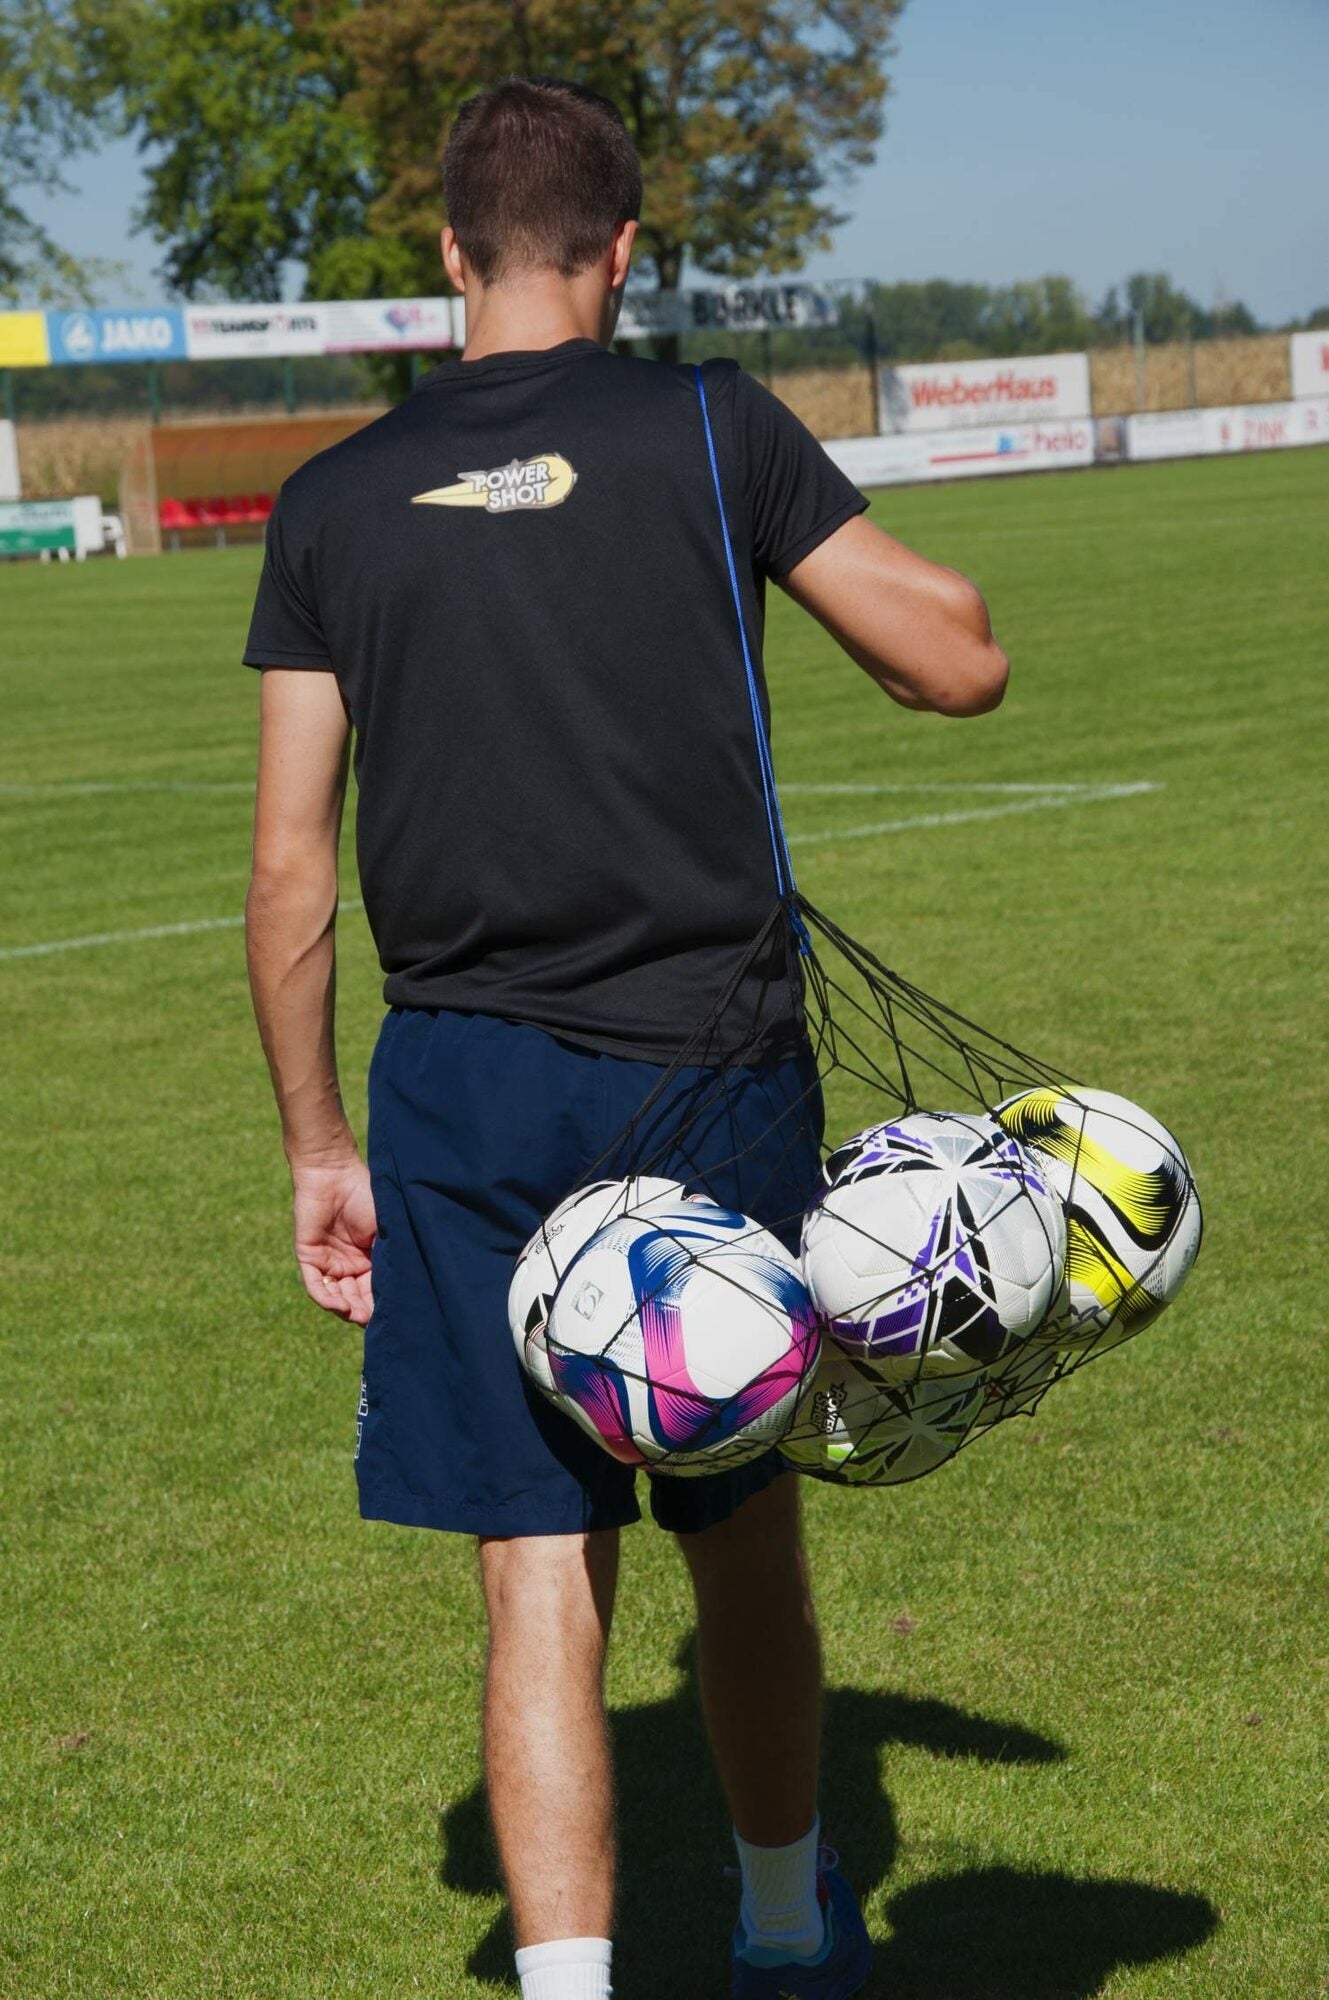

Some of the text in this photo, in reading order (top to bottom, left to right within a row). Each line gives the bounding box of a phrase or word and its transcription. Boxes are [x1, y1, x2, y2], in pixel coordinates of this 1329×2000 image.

[102, 316, 173, 352] JAKO
[911, 372, 1056, 408] WeberHaus
[471, 462, 549, 492] POWER
[489, 482, 549, 509] SHOT
